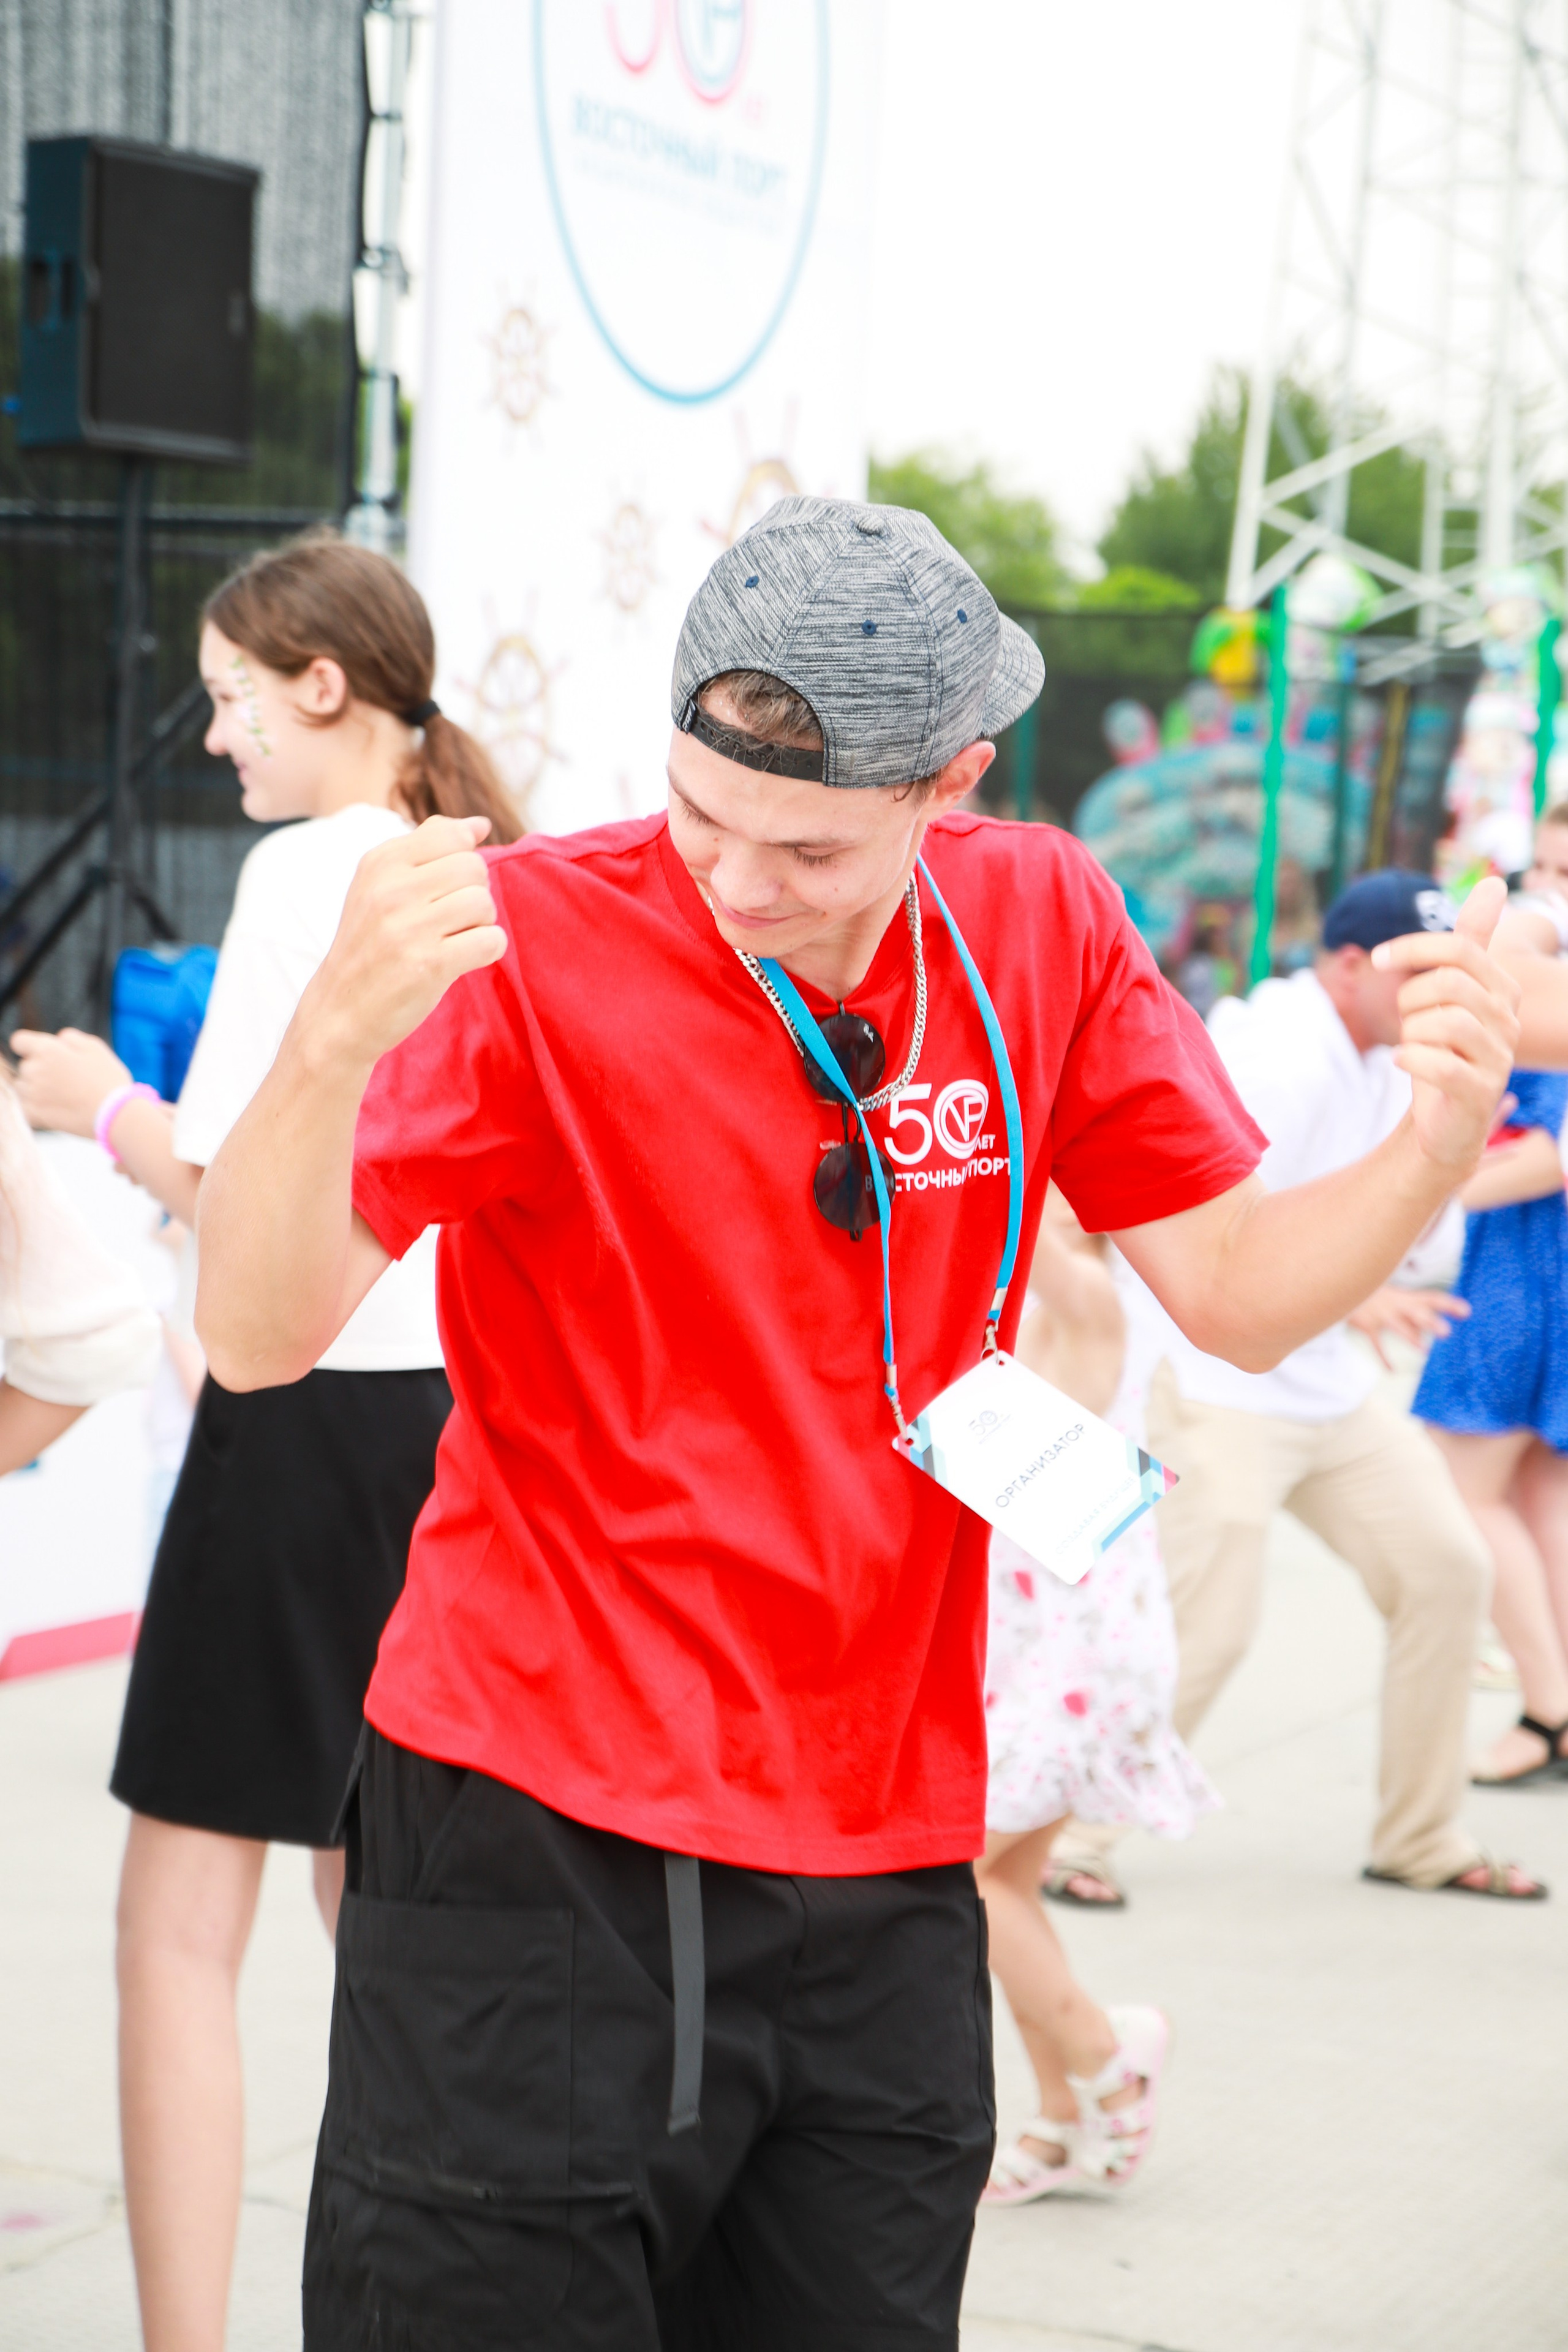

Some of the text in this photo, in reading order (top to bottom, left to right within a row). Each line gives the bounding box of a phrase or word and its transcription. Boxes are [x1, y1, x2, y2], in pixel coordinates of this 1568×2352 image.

[884, 1079, 996, 1165] 50 ЛЕТ
[865, 1166, 968, 1192] ВСТОЧНЫ
[995, 1423, 1084, 1507] ОРГАНИЗАТОР
